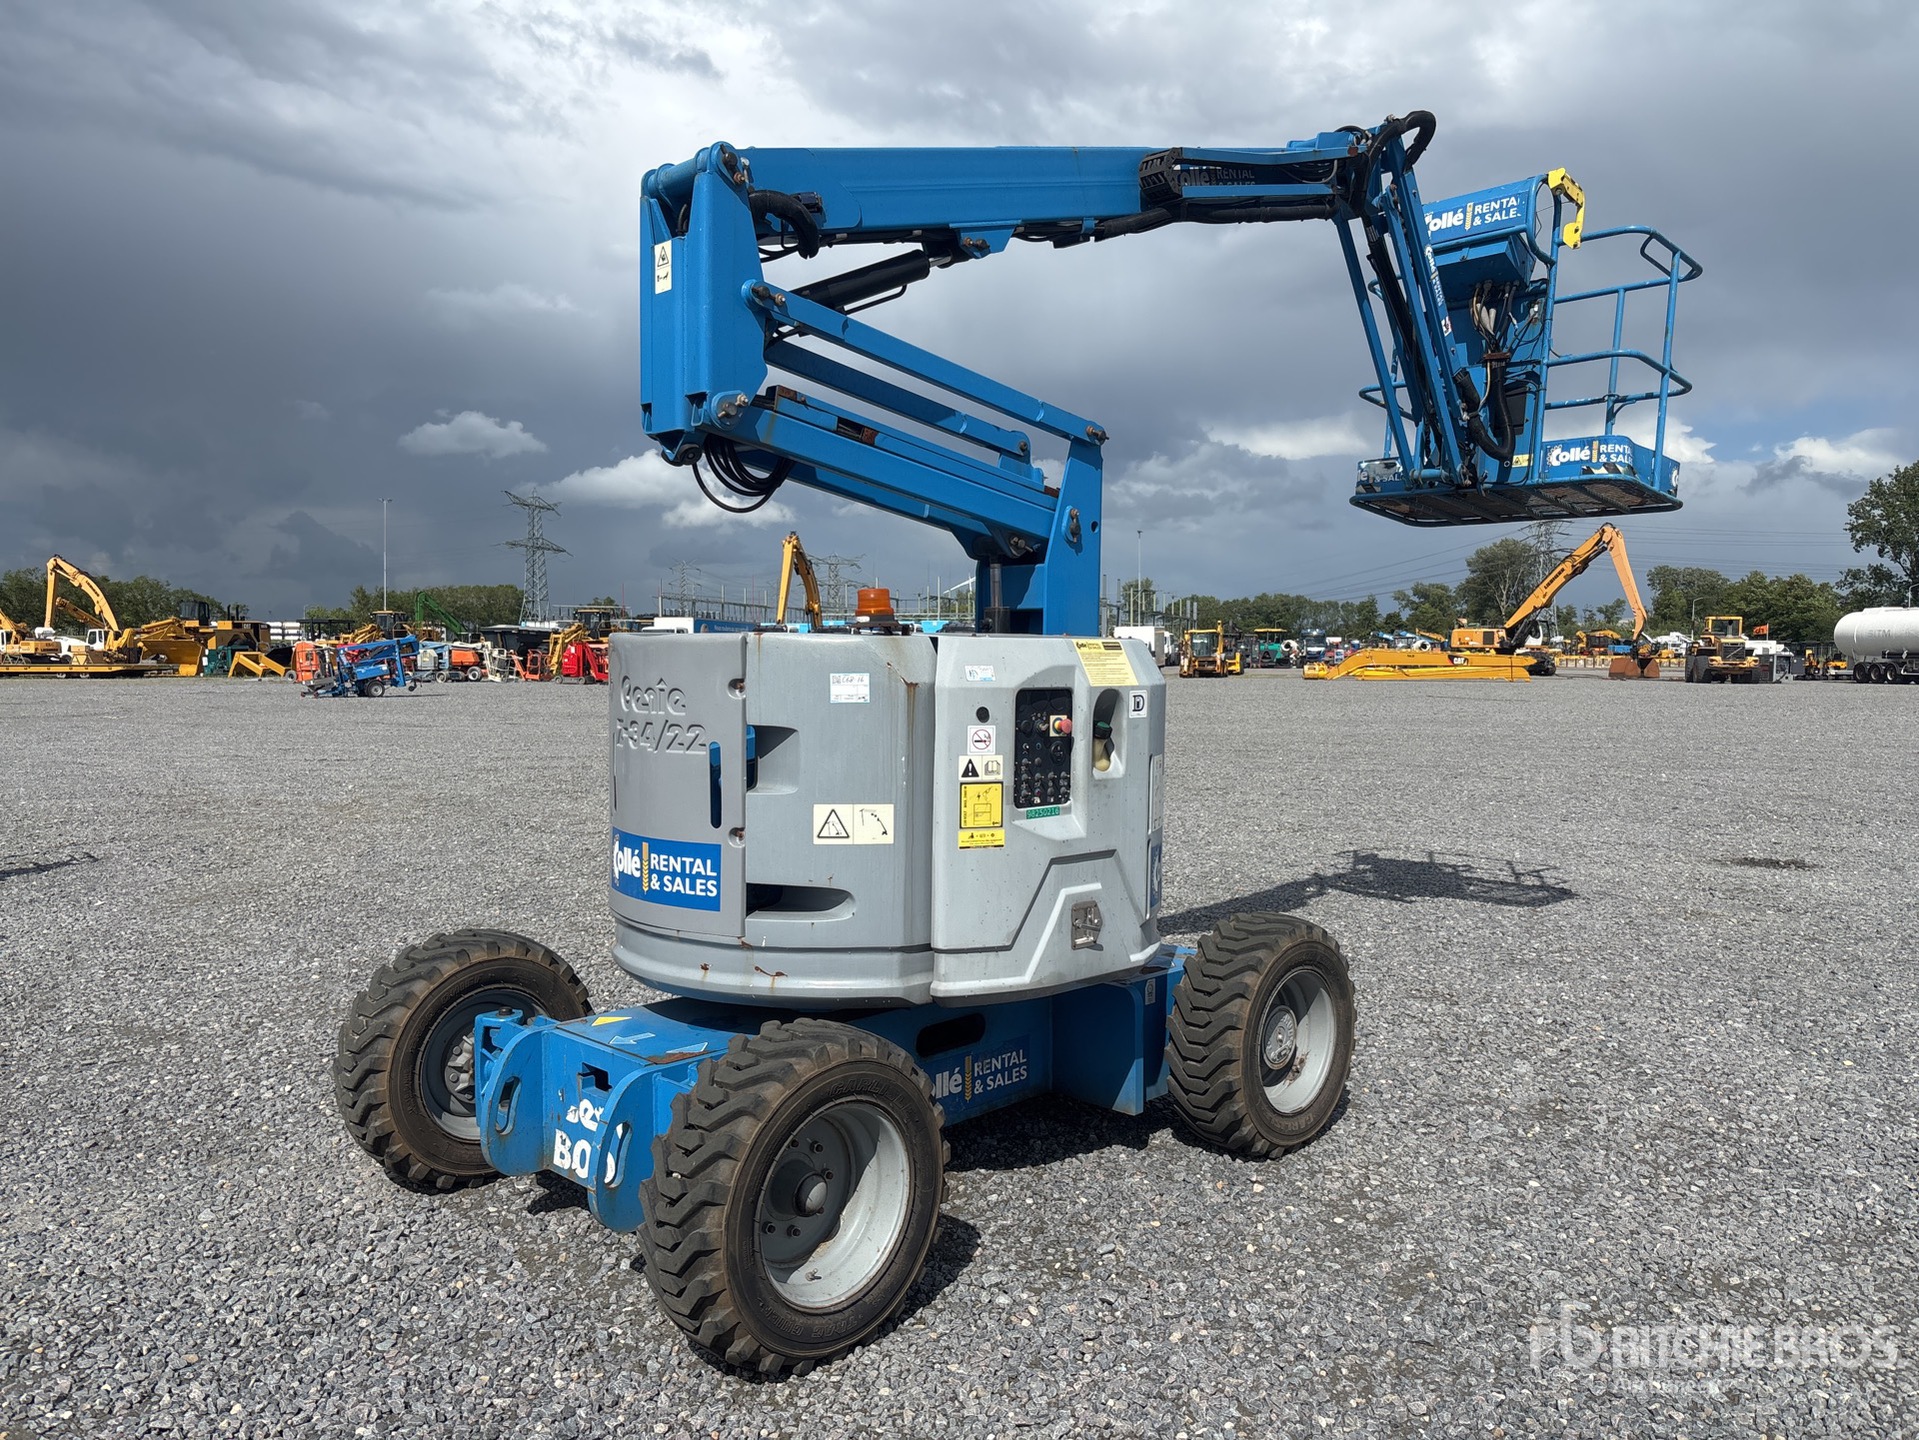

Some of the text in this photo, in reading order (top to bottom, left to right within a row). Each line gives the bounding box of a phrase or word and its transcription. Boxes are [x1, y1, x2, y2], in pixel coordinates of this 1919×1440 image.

[1549, 446, 1590, 466] Collé
[650, 853, 717, 876] RENTAL
[650, 874, 717, 897] & SALES
[974, 1049, 1027, 1077] RENTAL
[974, 1066, 1027, 1094] & SALES
